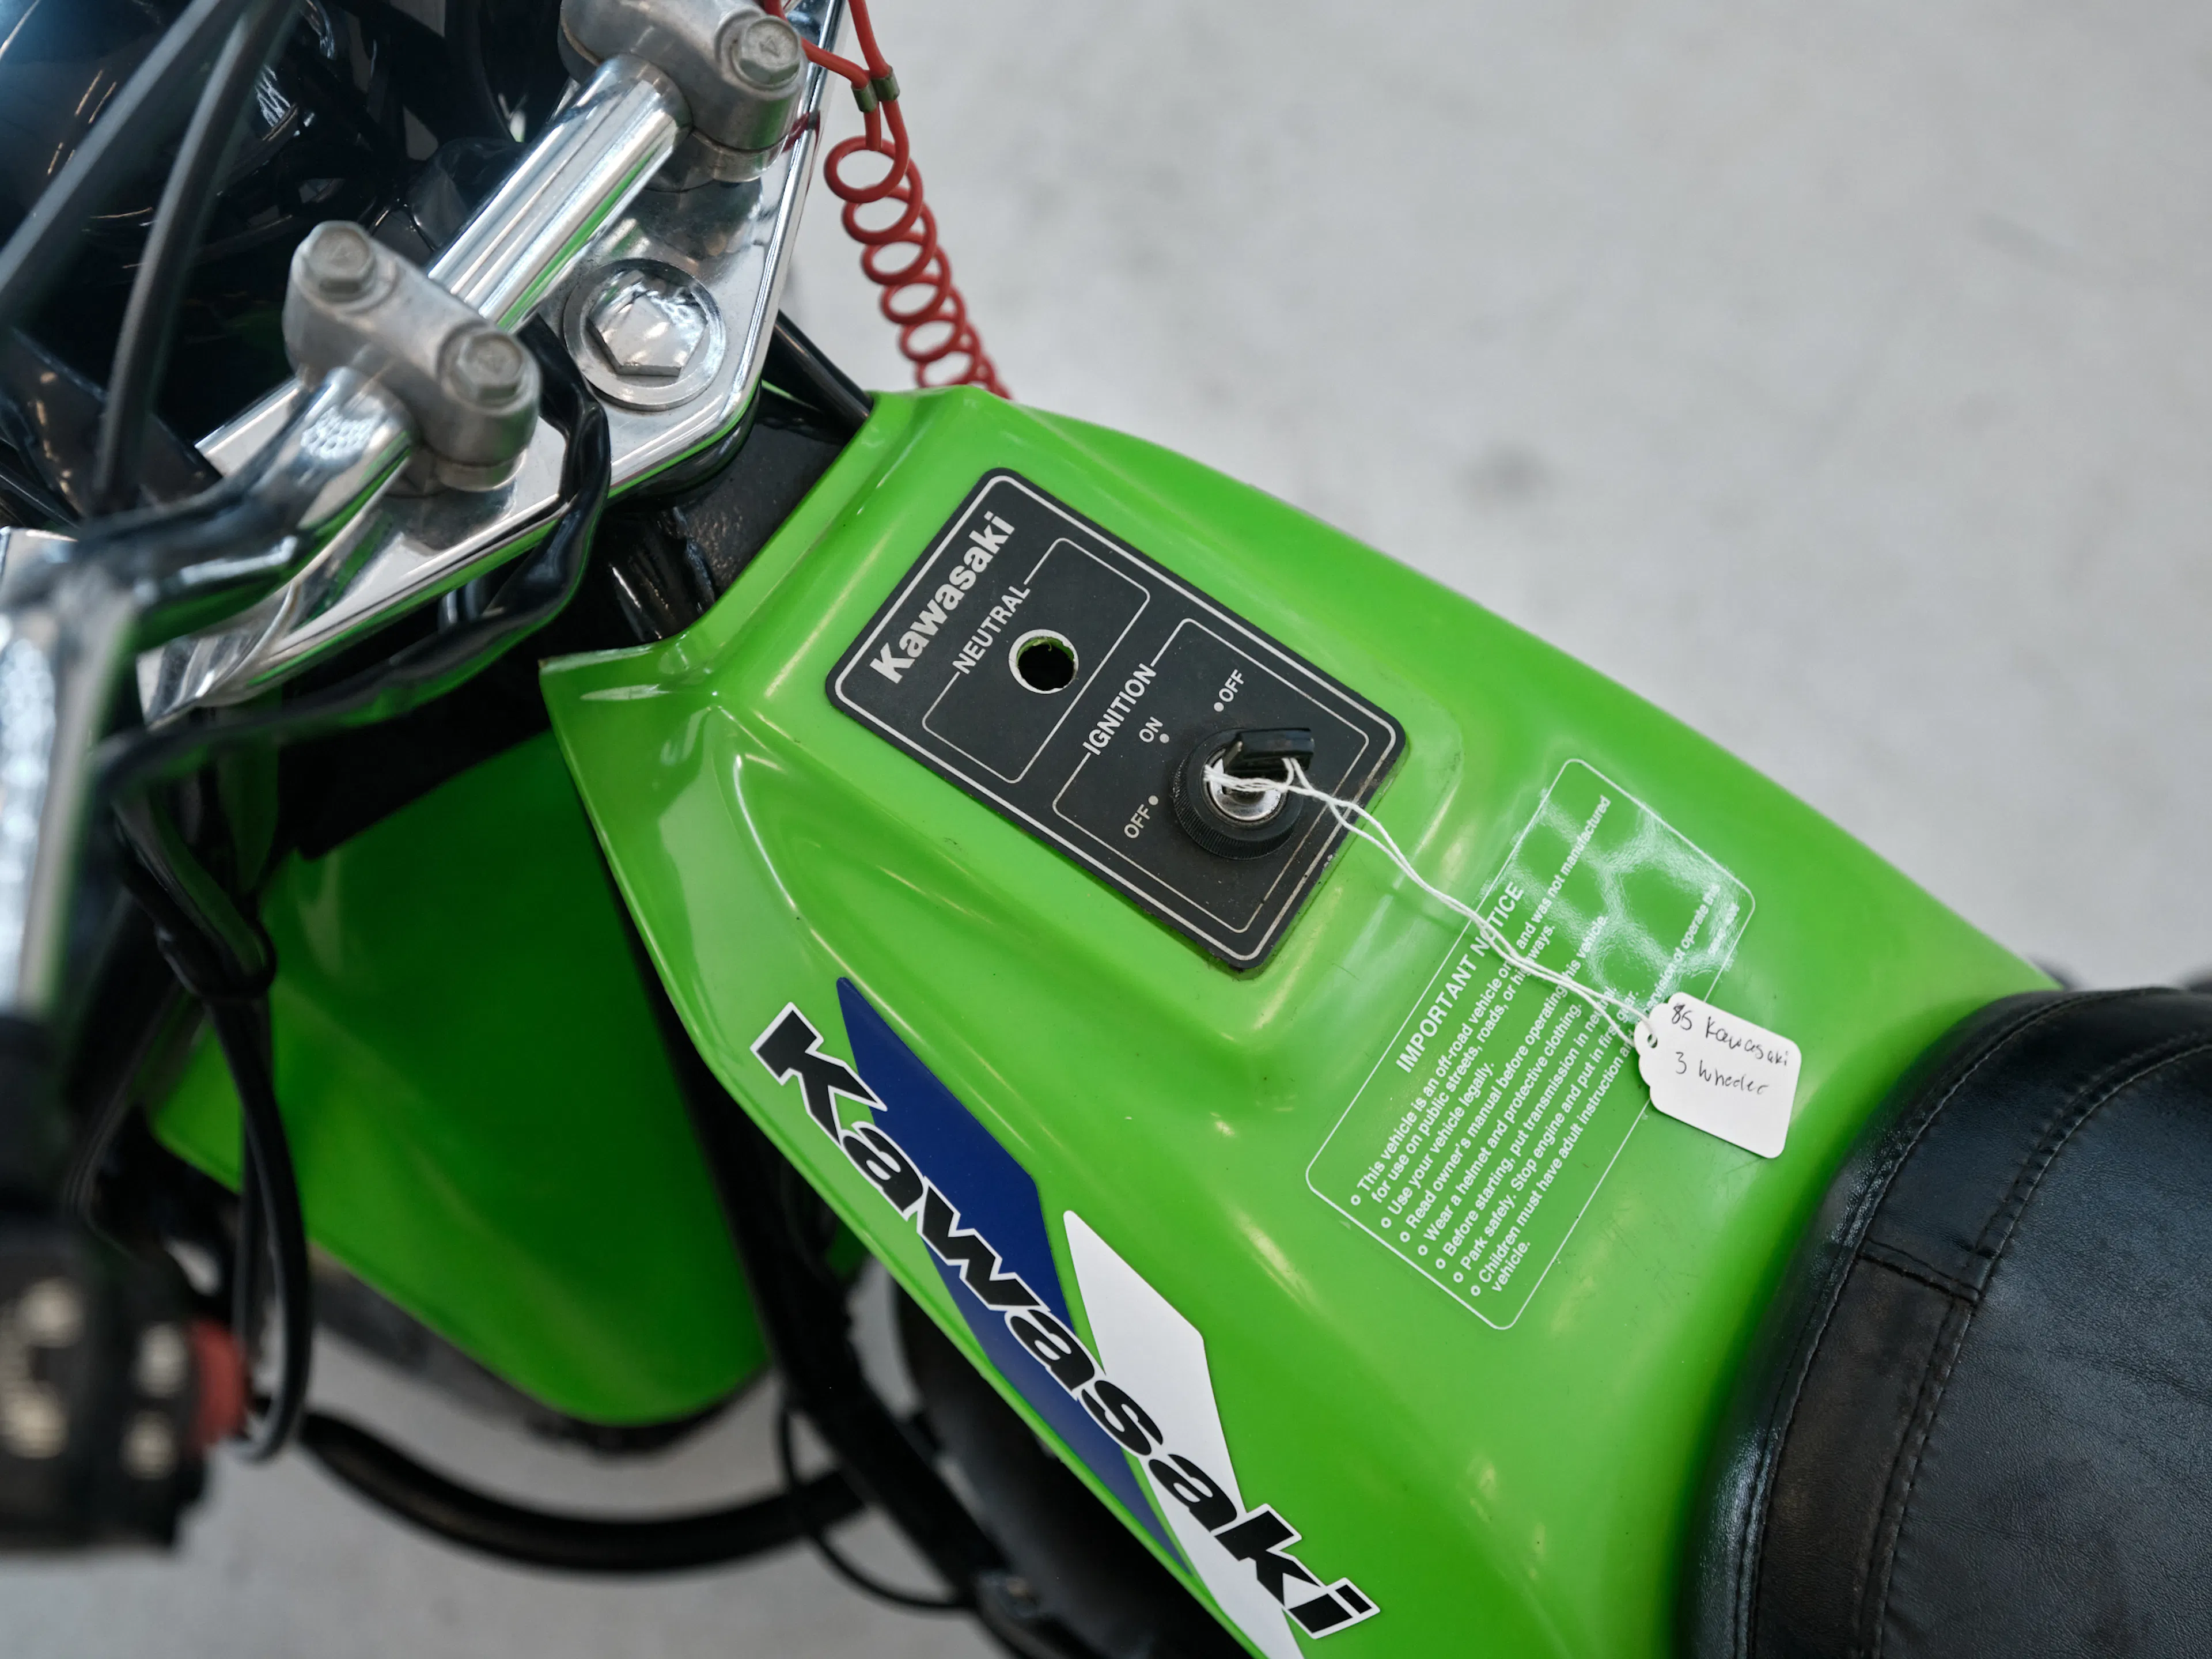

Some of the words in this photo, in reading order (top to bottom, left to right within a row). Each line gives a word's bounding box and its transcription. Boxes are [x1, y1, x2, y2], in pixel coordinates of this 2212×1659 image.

[870, 511, 1013, 683] Kawasaki
[953, 589, 1030, 673] NEUTRAL
[1083, 664, 1156, 755] IGNITION
[1219, 669, 1244, 702] OFF
[1139, 717, 1162, 742] ON
[1124, 804, 1150, 838] OFF
[1357, 1161, 1385, 1191] This
[1380, 1111, 1418, 1160] vehicle
[1410, 1097, 1427, 1112] is
[1423, 1078, 1440, 1097] an
[1435, 1022, 1474, 1078] off-road
[1468, 978, 1502, 1024] vehicle
[1516, 921, 1536, 950] and
[1531, 897, 1553, 923] was
[1544, 874, 1565, 899] not
[1560, 794, 1611, 876] manufactured
[1396, 953, 1477, 1073] IMPORTANT
[1544, 1004, 1582, 1057] clothing.
[1371, 1180, 1391, 1203] for
[1387, 1154, 1410, 1180] use
[1406, 1134, 1423, 1154] on
[1418, 1092, 1450, 1137] public
[1445, 1046, 1483, 1093] streets,
[1476, 1004, 1509, 1043] roads,
[1502, 984, 1516, 1001] or
[1405, 1189, 1437, 1229] Read
[1433, 1138, 1471, 1192] owner's
[1467, 1085, 1502, 1138] manual
[1495, 1045, 1529, 1089] before
[1525, 982, 1568, 1046] operating
[1559, 960, 1581, 984] his
[1479, 1225, 1521, 1283] Children
[1516, 1190, 1543, 1226] must
[1536, 1158, 1563, 1192] have
[1558, 1123, 1584, 1159] adult
[1576, 1056, 1624, 1125] instruction
[1681, 904, 1709, 949] operate
[1503, 1056, 1548, 1124] protective
[1675, 1051, 1687, 1074] 3
[1387, 1187, 1413, 1215] Use
[1408, 1153, 1434, 1190] your
[1429, 1106, 1465, 1153] vehicle
[1458, 1062, 1494, 1107] legally.
[1442, 1210, 1479, 1257] Before
[1475, 1157, 1516, 1211] starting,
[1509, 1129, 1529, 1157] put
[1522, 1047, 1580, 1131] transmission
[1573, 1033, 1589, 1047] in
[1455, 1147, 1492, 1195] helmet
[1460, 1236, 1488, 1271] Park
[1484, 1194, 1517, 1237] safely.
[1510, 1158, 1537, 1191] Stop
[1533, 1112, 1565, 1159] engine
[1561, 1084, 1582, 1113] and
[1577, 1062, 1596, 1089] put
[1589, 1048, 1604, 1063] in
[1487, 1119, 1508, 1149] and
[1423, 1205, 1453, 1241] Wear
[1450, 1195, 1462, 1206] a
[1491, 1241, 1531, 1291] vehicle.
[751, 1002, 1380, 1639] Kawasaki
